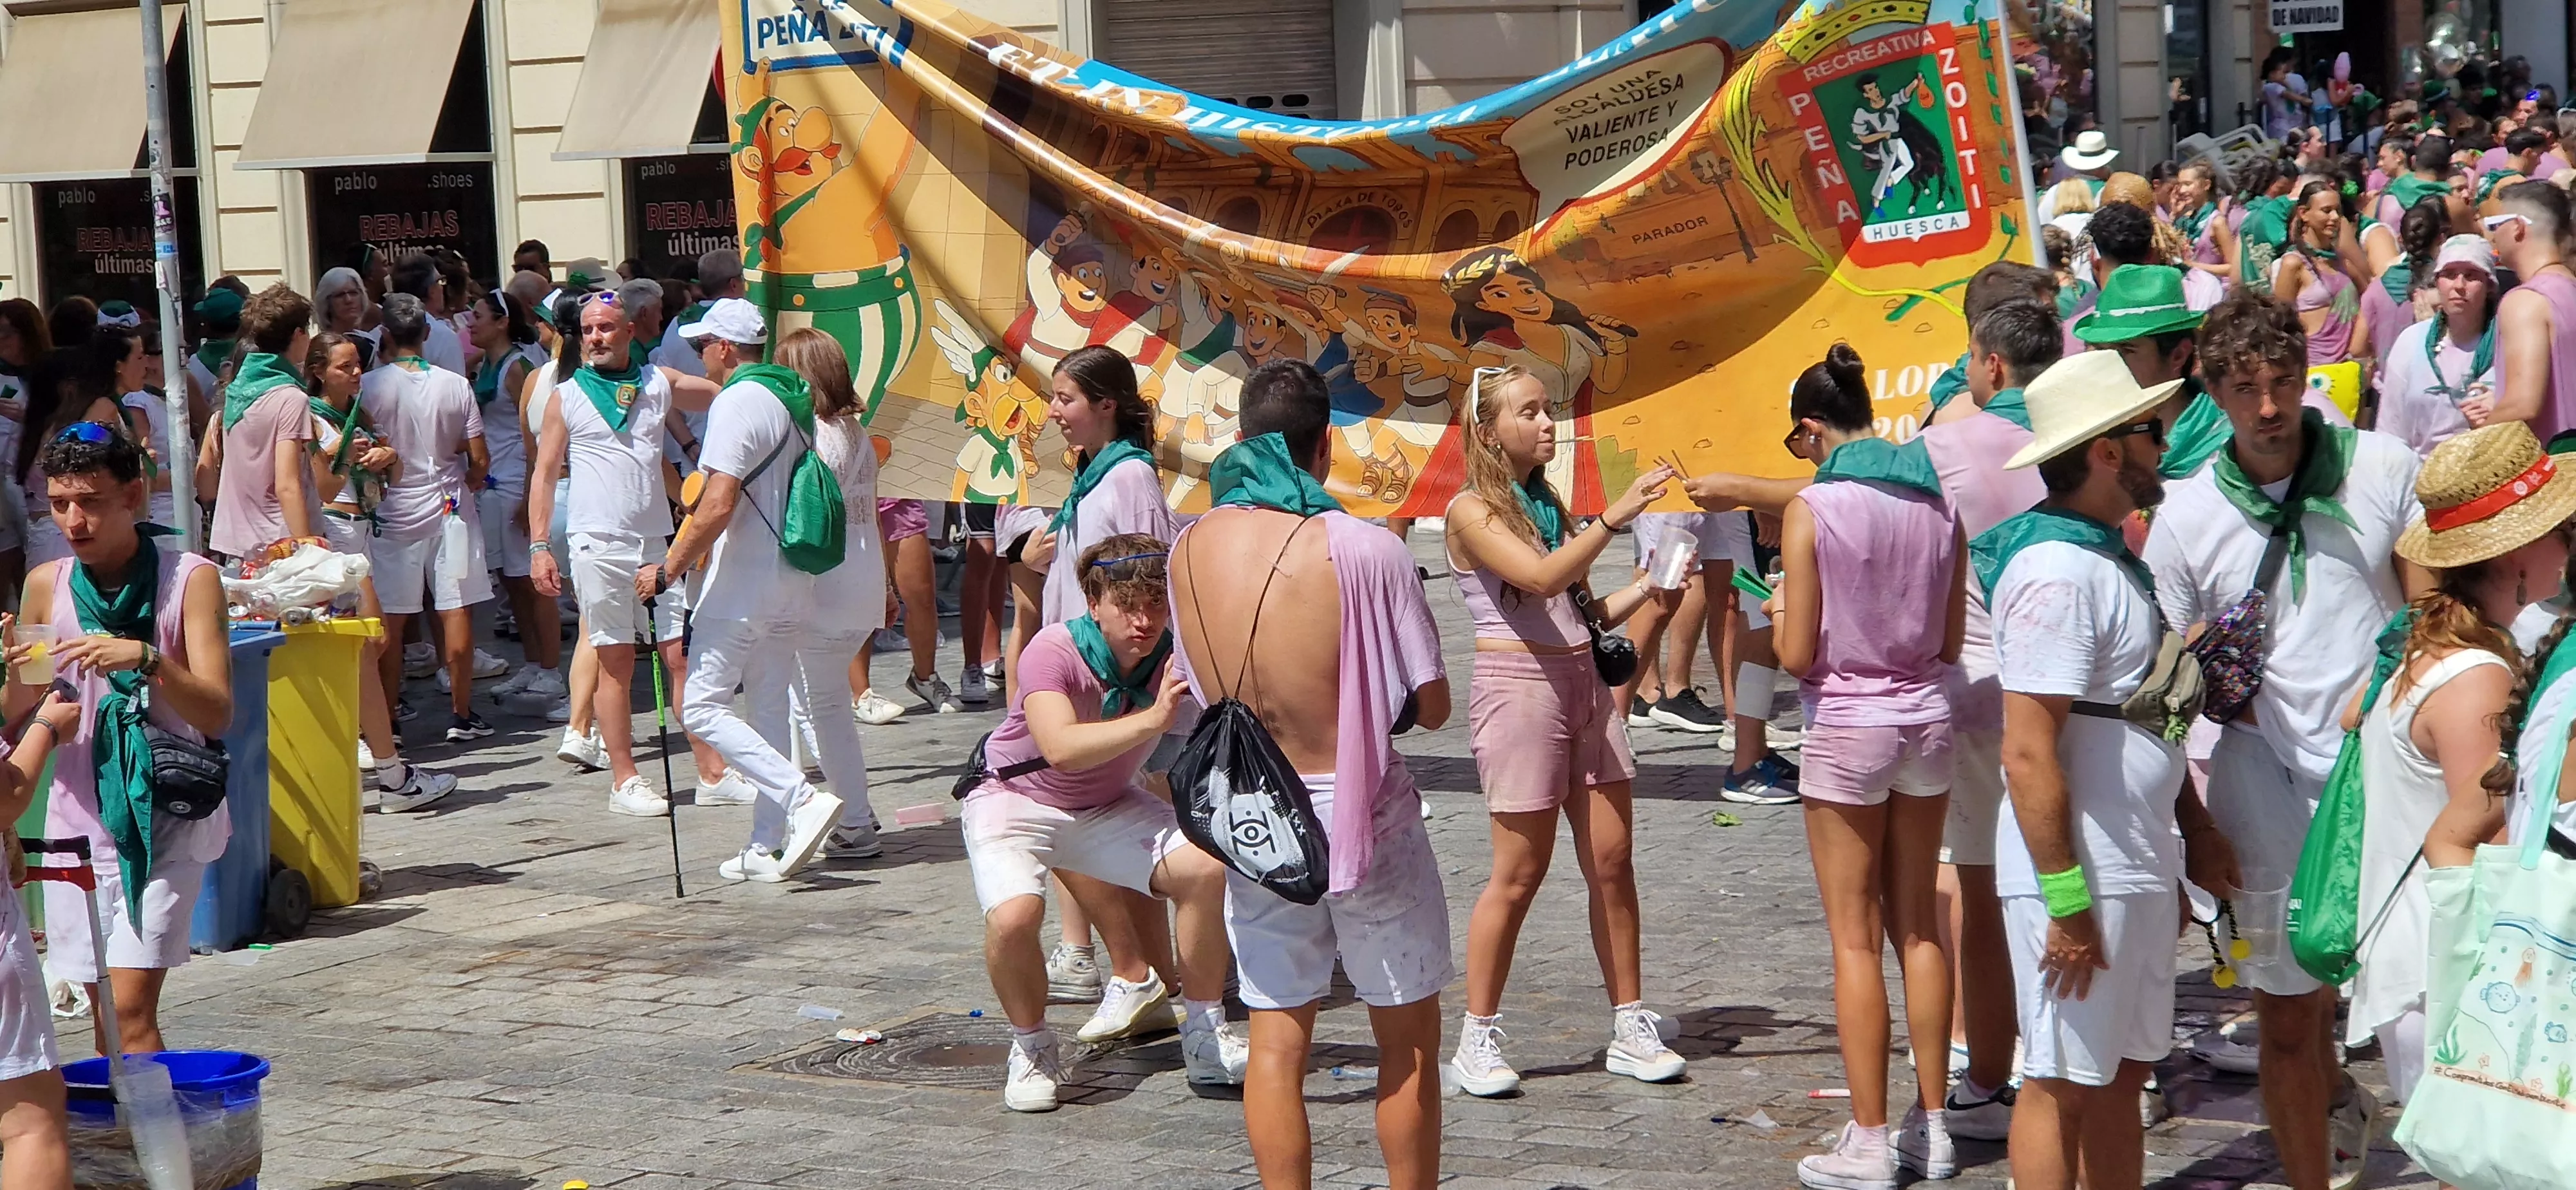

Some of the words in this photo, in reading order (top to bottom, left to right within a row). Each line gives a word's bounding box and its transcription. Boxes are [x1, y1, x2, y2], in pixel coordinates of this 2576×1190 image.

[756, 5, 829, 50] PEÑA
[2273, 8, 2287, 26] DE
[2290, 5, 2339, 24] NAVIDAD
[1803, 29, 1936, 82] RECREATIVA
[1553, 73, 1685, 127] ALCALDESA
[1554, 92, 1602, 115] SOY
[1609, 69, 1662, 93] UNA
[1565, 105, 1660, 144] VALIENTE
[1667, 99, 1678, 118] Y
[1938, 48, 1982, 209] ZOITI
[1564, 127, 1669, 171] PODEROSA
[1787, 92, 1859, 223] PEÑA
[334, 171, 377, 194] pablo
[427, 171, 474, 189] .shoes
[641, 160, 676, 180] pablo
[58, 187, 96, 208] pablo
[1358, 192, 1375, 203] DE
[1381, 194, 1413, 228] TOROS
[359, 209, 460, 241] REBAJAS
[645, 199, 738, 231] REBAJA
[1631, 215, 1709, 245] PARADOR
[1873, 220, 1960, 240] HUESCA
[76, 226, 154, 252] REBAJA
[94, 253, 155, 274] últimas
